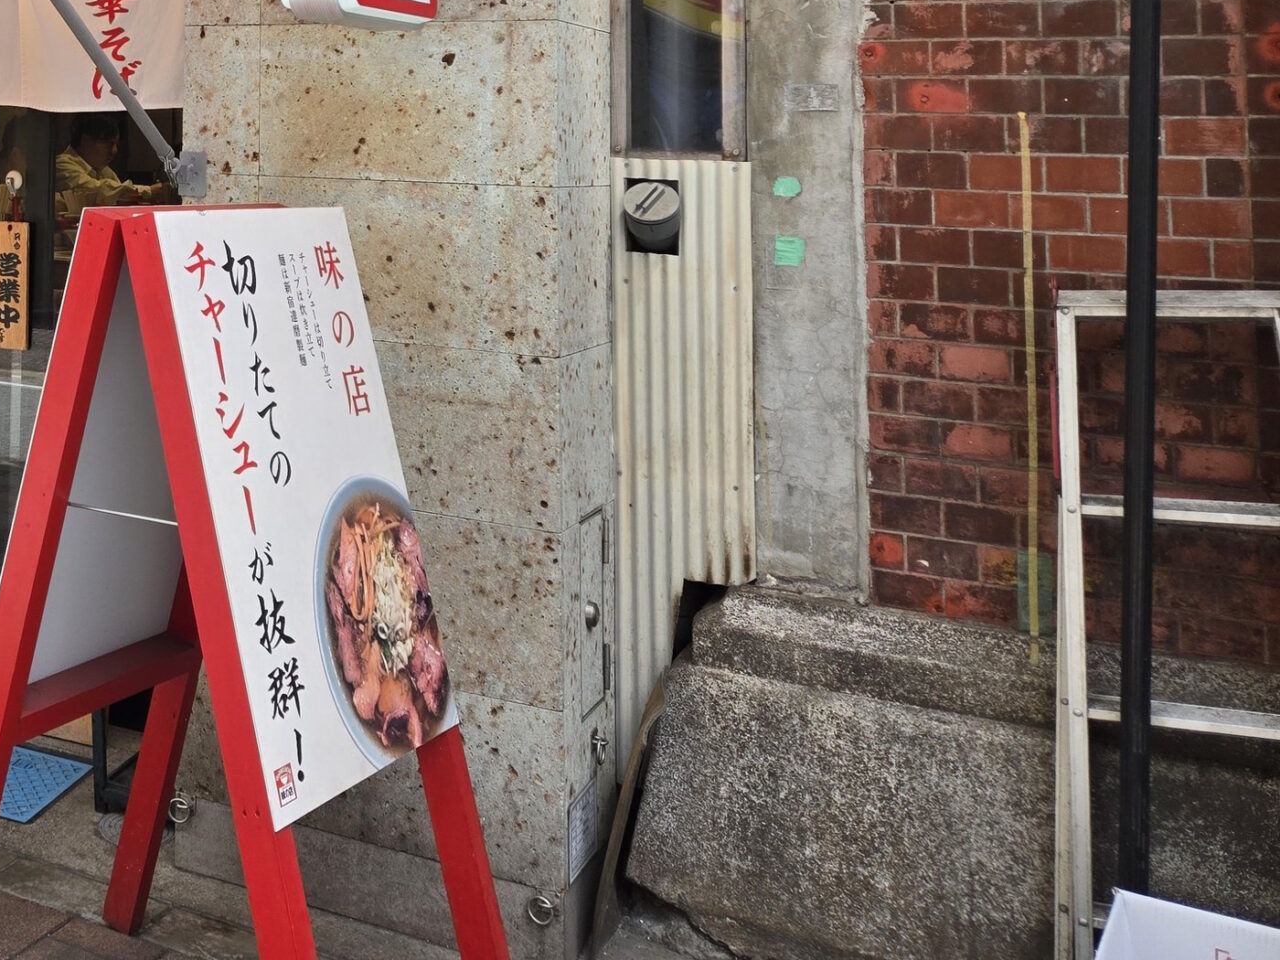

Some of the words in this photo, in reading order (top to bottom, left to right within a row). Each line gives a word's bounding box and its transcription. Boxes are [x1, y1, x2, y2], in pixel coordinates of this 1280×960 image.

[222, 240, 292, 487] 切りたての
[313, 241, 371, 417] 味の店
